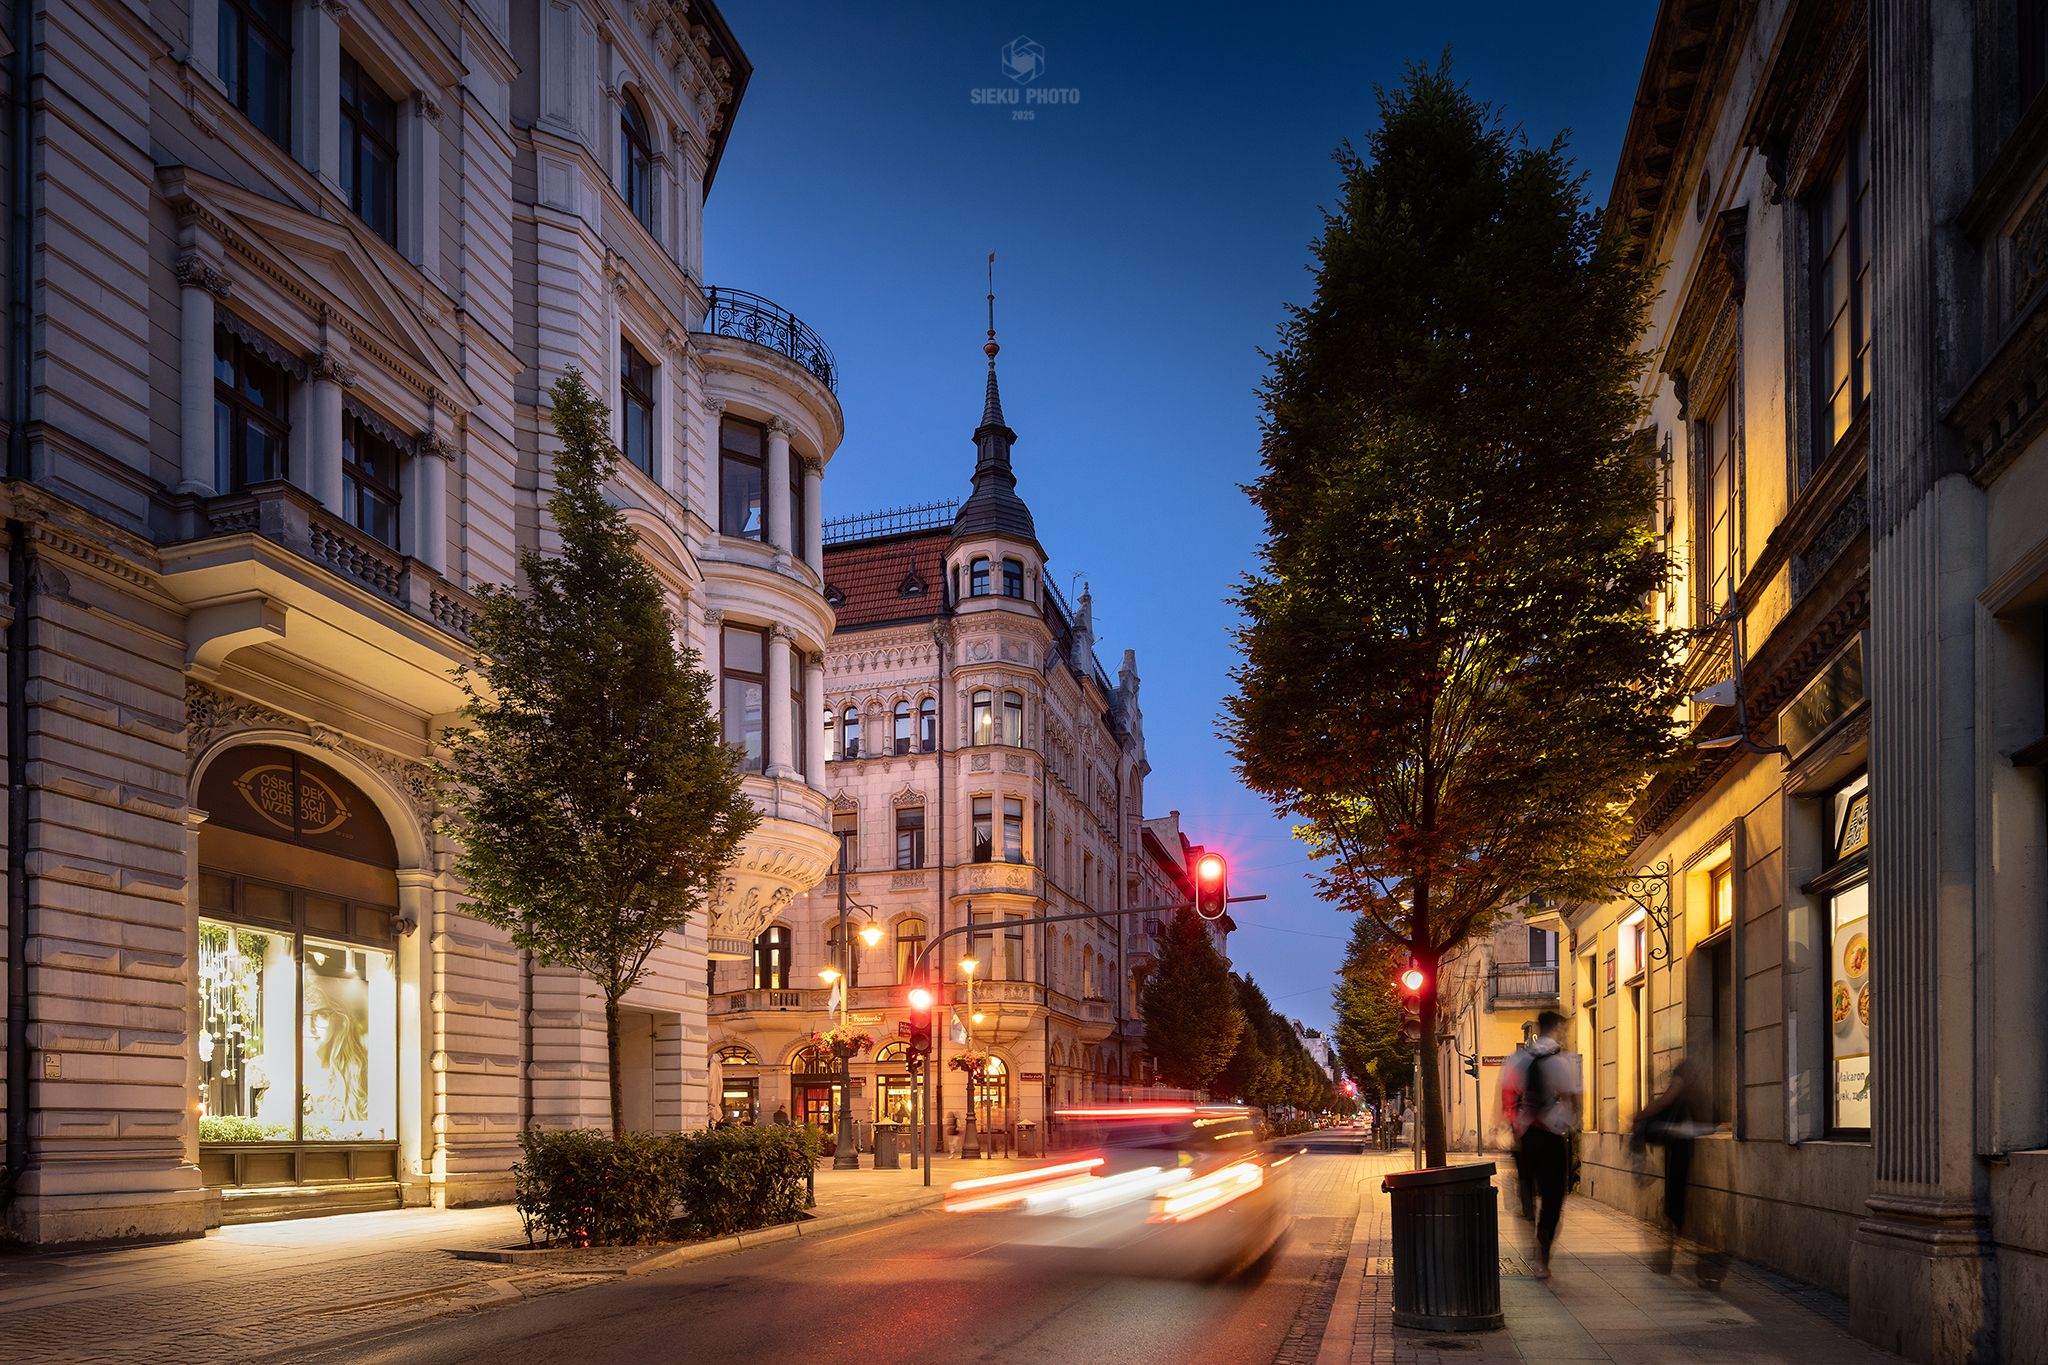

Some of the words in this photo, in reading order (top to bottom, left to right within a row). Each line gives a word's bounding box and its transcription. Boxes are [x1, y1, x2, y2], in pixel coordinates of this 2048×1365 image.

[261, 774, 326, 802] OŚRODEK
[261, 786, 326, 814] KOREKCJI
[261, 798, 326, 824] WZROKU
